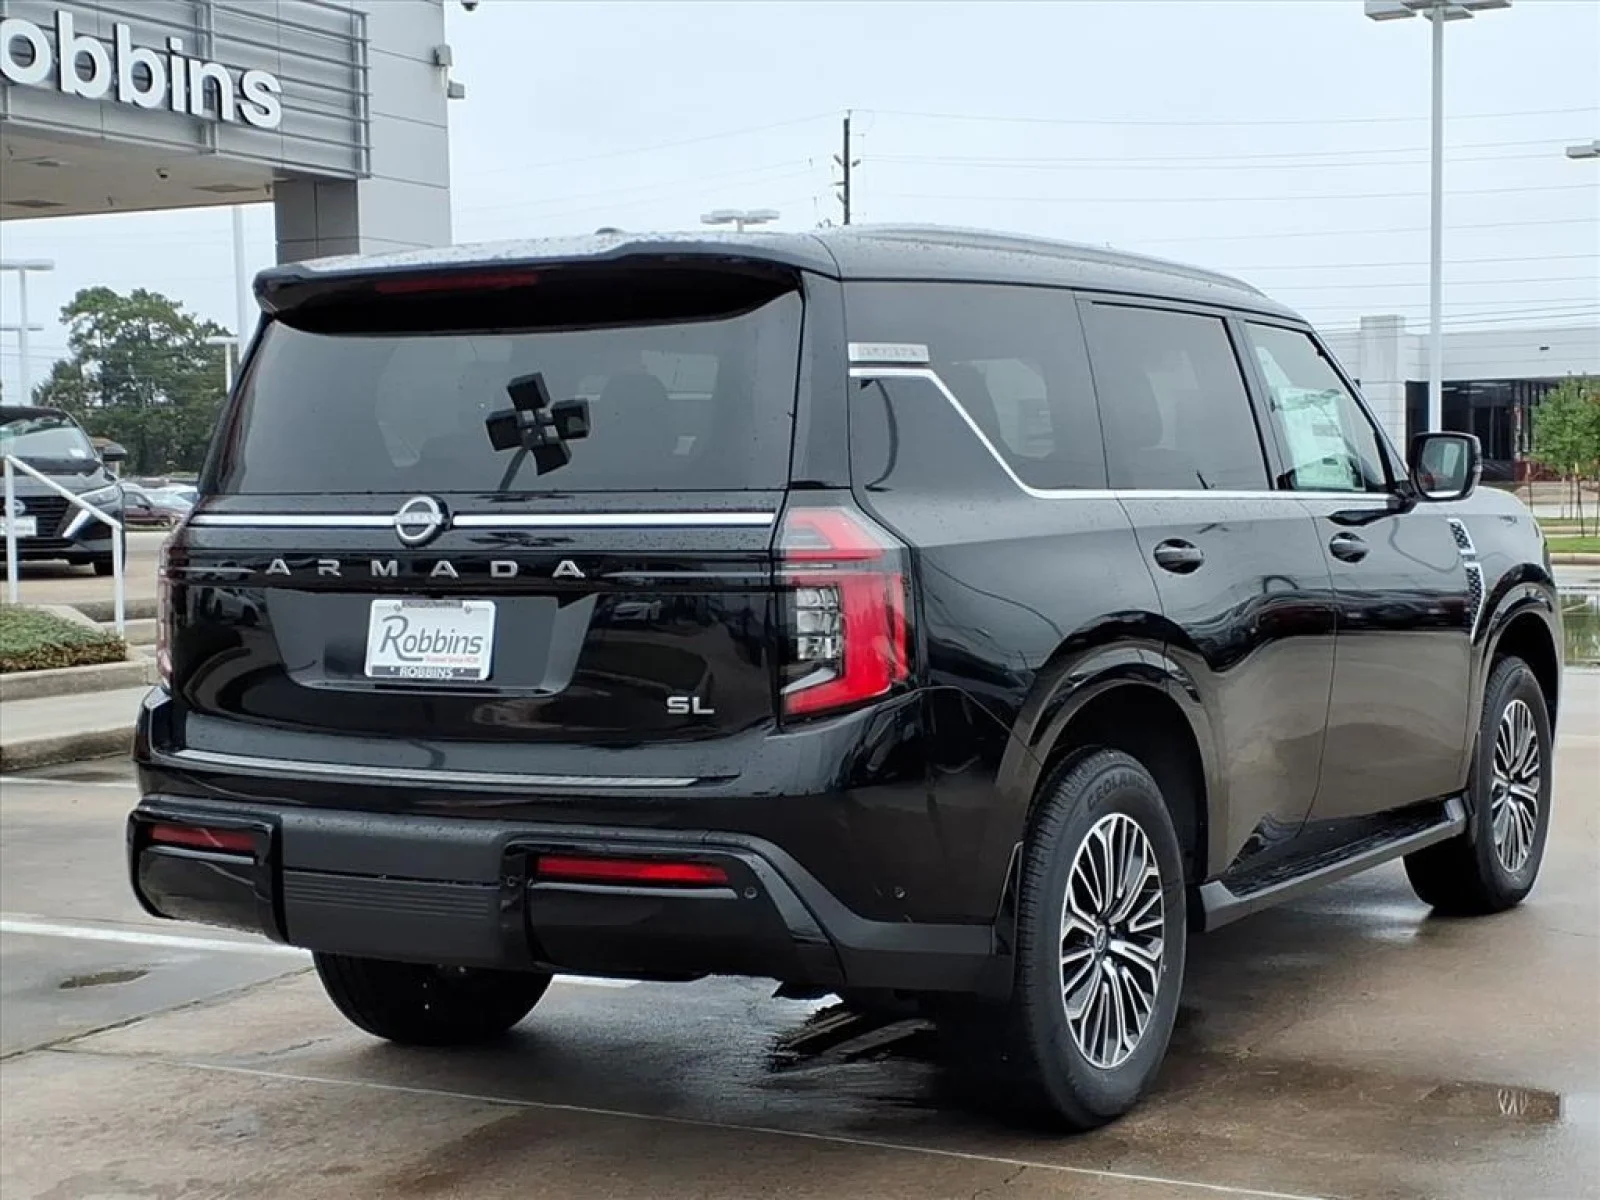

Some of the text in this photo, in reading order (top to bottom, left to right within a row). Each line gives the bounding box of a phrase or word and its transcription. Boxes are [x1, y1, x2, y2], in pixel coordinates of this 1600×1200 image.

[0, 10, 282, 128] obbins
[265, 558, 586, 578] ARMADA
[379, 615, 483, 662] Robbins
[666, 696, 715, 714] SL
